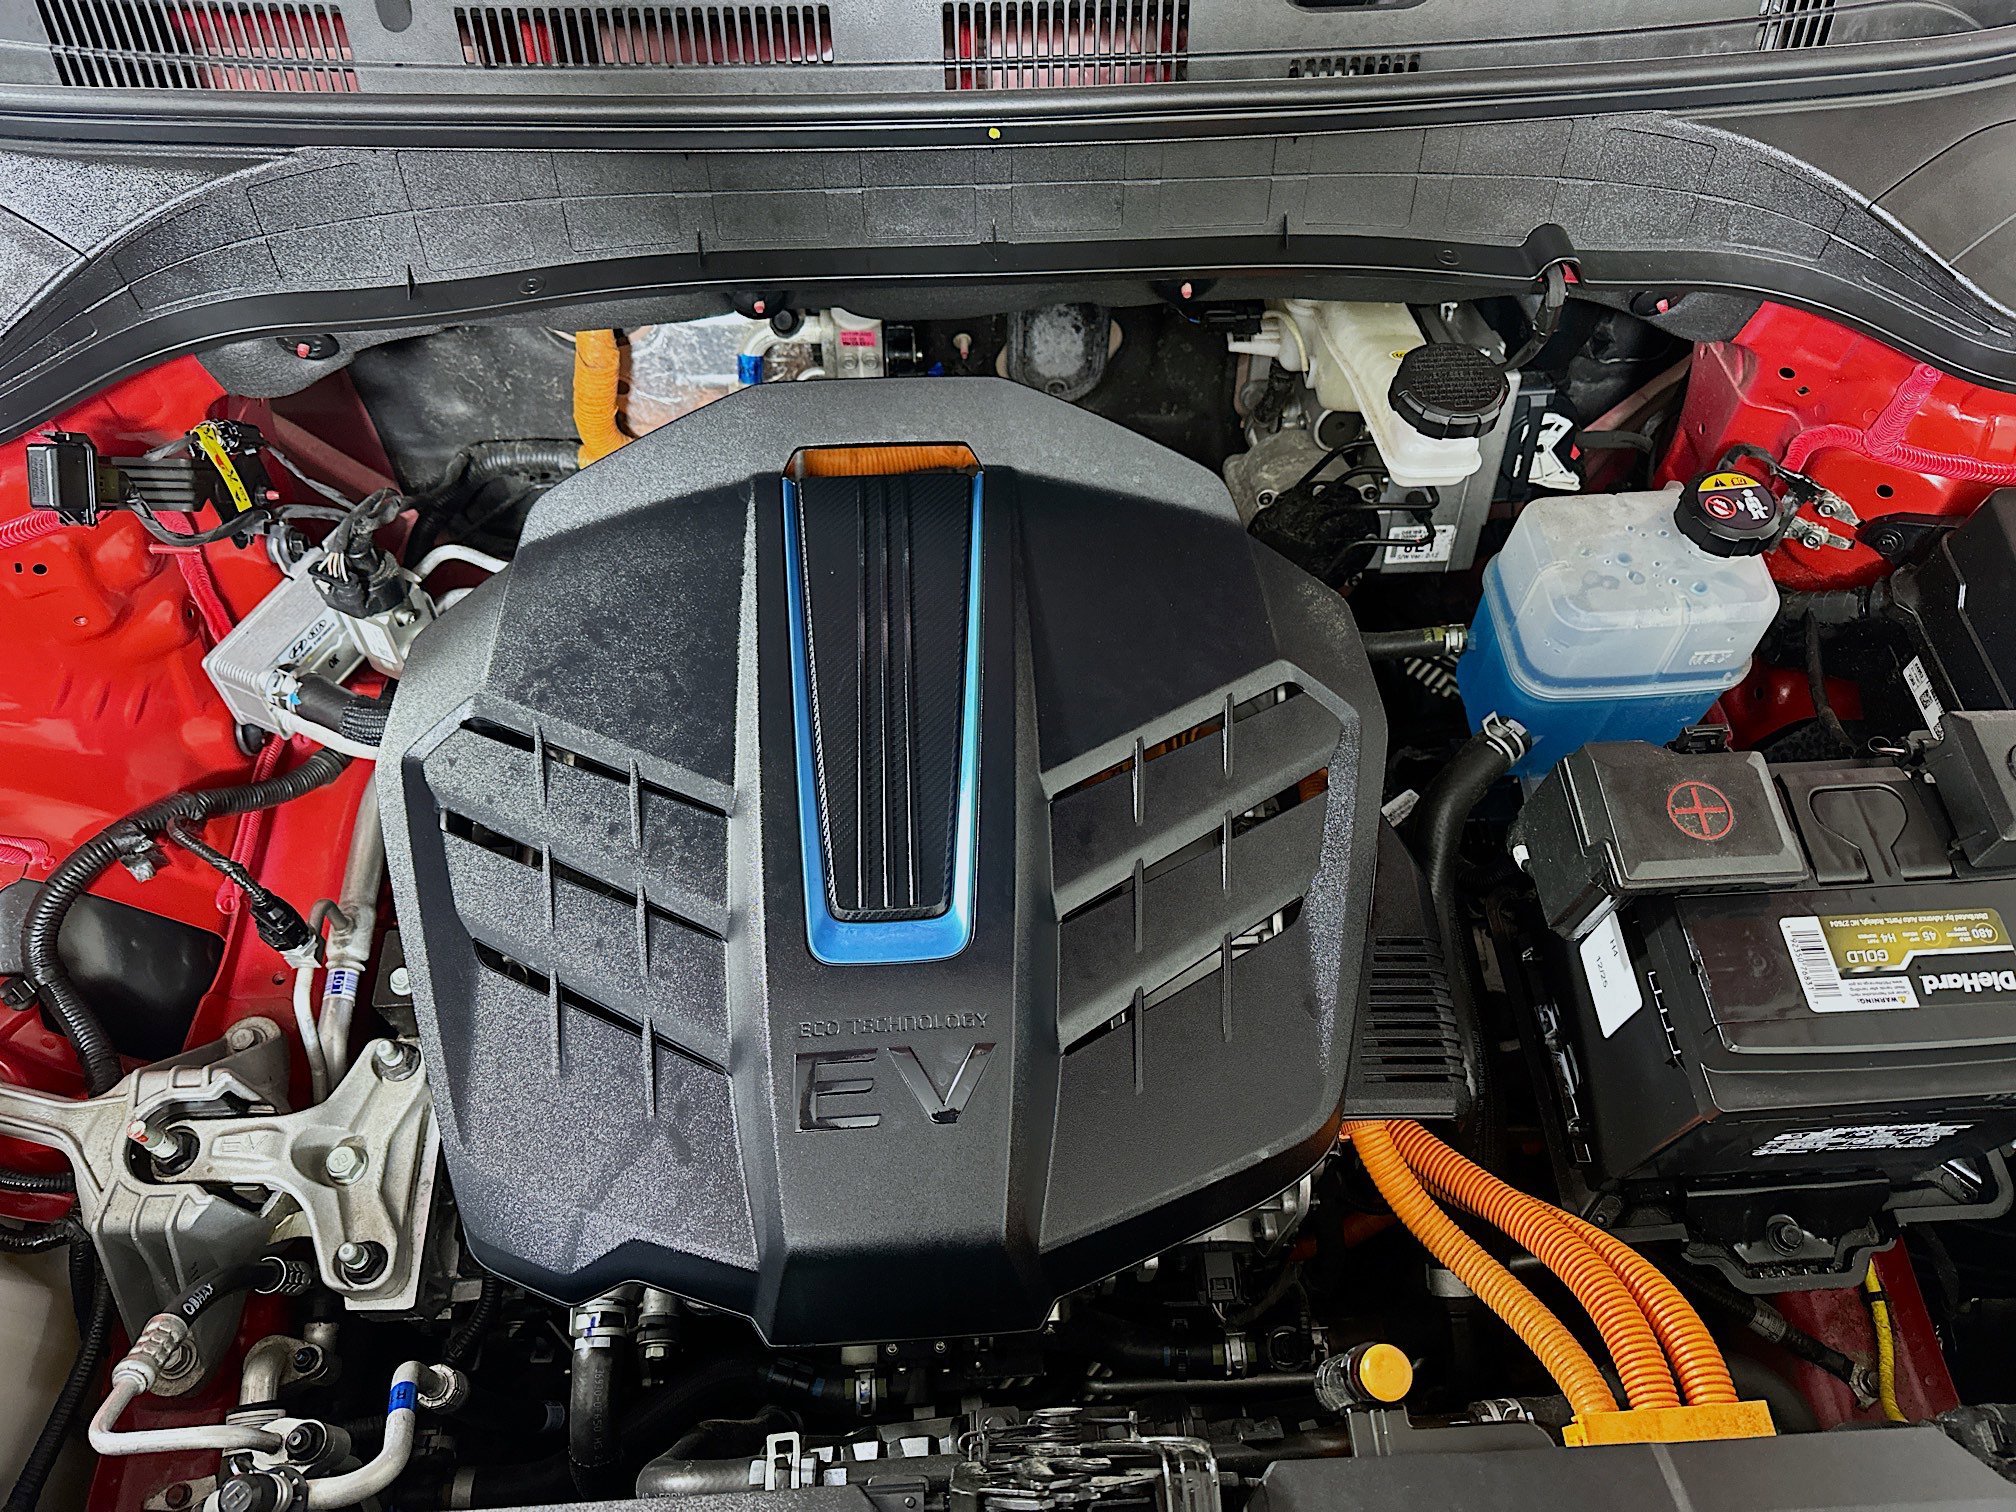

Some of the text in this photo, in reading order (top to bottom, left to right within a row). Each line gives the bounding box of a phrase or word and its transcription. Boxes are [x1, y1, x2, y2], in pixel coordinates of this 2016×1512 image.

[309, 622, 325, 638] KIA
[328, 653, 340, 668] OK
[1688, 653, 1732, 667] MAX
[1880, 932, 1897, 943] H4
[1921, 931, 1937, 941] 45
[1790, 938, 1804, 963] 92350
[1800, 966, 1815, 990] 76831
[1846, 949, 1890, 963] GOLD
[1921, 970, 2016, 995] DieHard
[798, 1013, 989, 1038] ECO TECHNOLOGY
[793, 1042, 996, 1134] EV
[221, 1134, 269, 1154] EV
